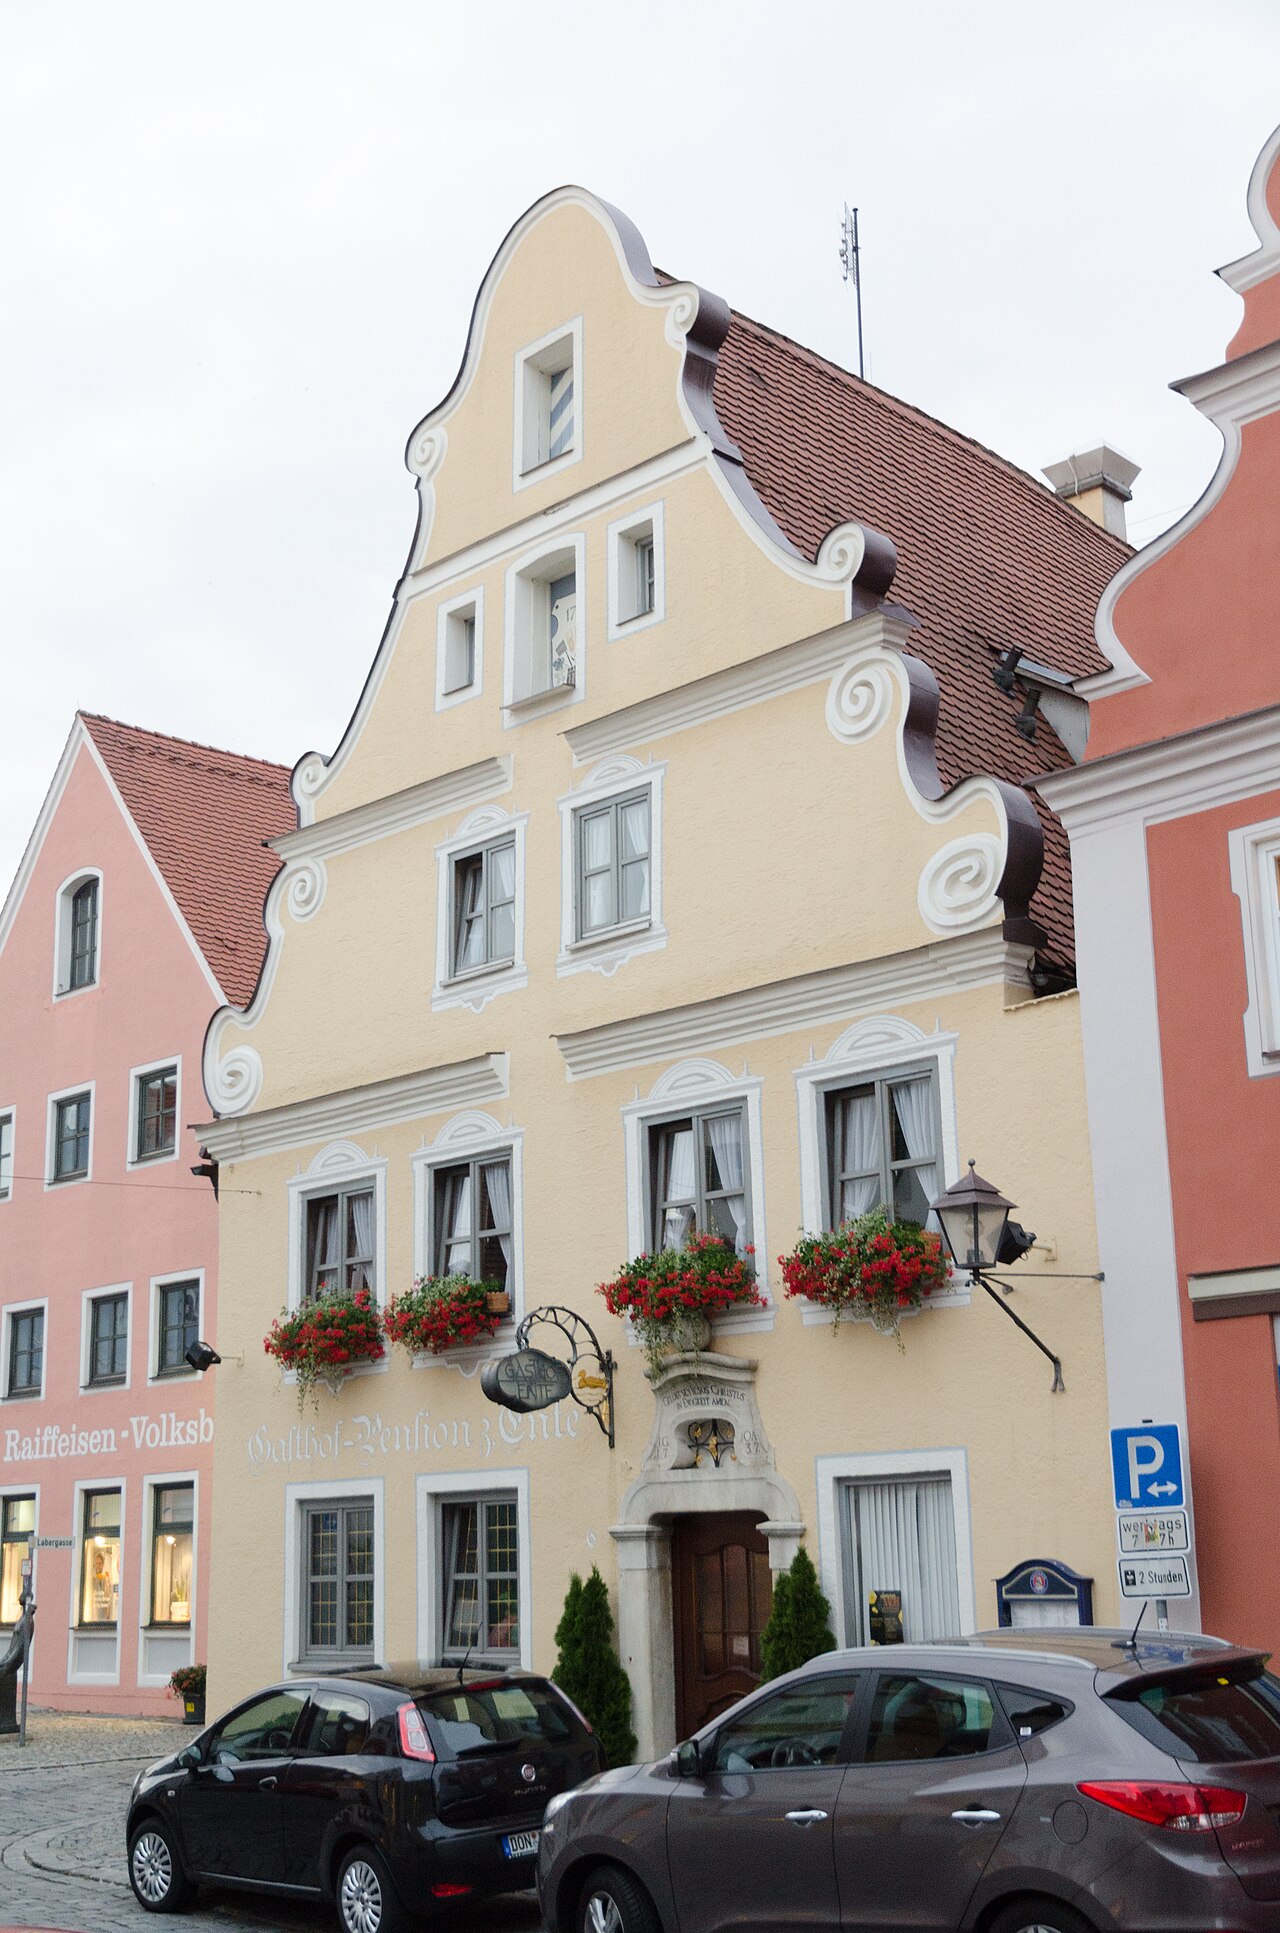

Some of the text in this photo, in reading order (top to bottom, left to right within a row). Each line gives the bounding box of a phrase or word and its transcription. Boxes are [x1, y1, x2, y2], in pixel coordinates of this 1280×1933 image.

[504, 1356, 560, 1382] GASTHO
[516, 1382, 555, 1401] ENTE
[711, 1385, 745, 1401] CHRISTUS
[1126, 1435, 1165, 1499] P
[37, 1538, 72, 1548] Labergasse
[1138, 1570, 1184, 1584] 2 Stunden
[510, 1833, 532, 1851] DON
